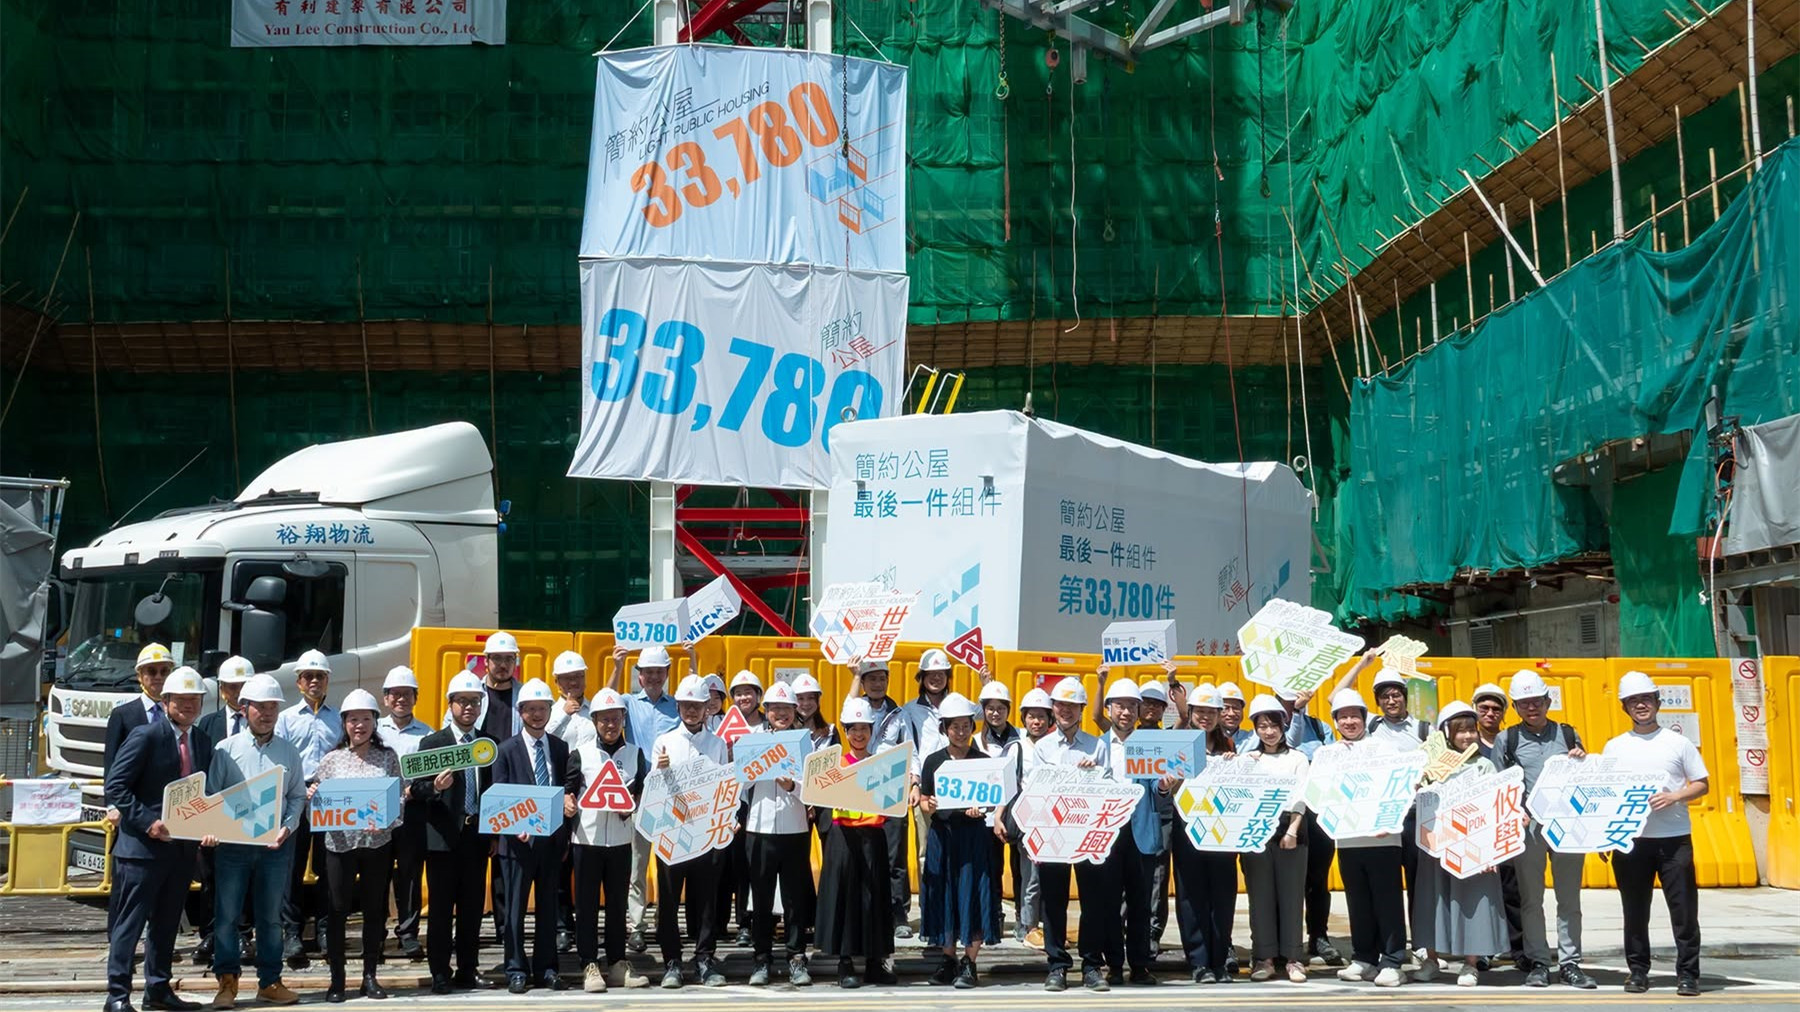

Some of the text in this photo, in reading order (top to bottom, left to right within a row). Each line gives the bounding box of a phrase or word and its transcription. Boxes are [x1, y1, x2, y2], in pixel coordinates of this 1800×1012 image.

[264, 24, 290, 36] Yau
[295, 24, 320, 35] Lee
[324, 23, 415, 35] Construction
[420, 22, 449, 36] Co.,
[604, 87, 700, 170] 簡約公屋
[638, 81, 770, 161] LIGHT PUBLIC HOUSING
[630, 81, 840, 228] 33,780
[820, 309, 863, 352] 簡約
[832, 335, 882, 370] 公屋
[591, 308, 883, 454] 33,780
[856, 449, 950, 481] 簡約公屋
[853, 487, 1003, 518] 最後一件組件
[1059, 499, 1126, 534] 簡約公屋
[276, 523, 375, 545] 裕翔物流
[1059, 535, 1157, 571] 最後一件組件
[1058, 574, 1176, 620] 第33,780件
[1223, 580, 1248, 612] 公屋
[616, 621, 677, 643] 33,780
[863, 605, 909, 659] 世運
[1104, 637, 1137, 646] 最後一件
[1289, 632, 1315, 648] TSING
[1104, 647, 1141, 663] MiC
[1283, 646, 1304, 658] FUK
[1284, 643, 1350, 691] 青福
[72, 699, 113, 718] SCANIA
[405, 748, 472, 774] 擺脫困境
[744, 743, 788, 781] 33,780
[1127, 746, 1163, 755] 最後一件
[807, 751, 837, 777] 簡約
[1127, 758, 1167, 775] MiC
[1423, 750, 1465, 780] 公屋
[689, 775, 714, 787] PUBLIC
[714, 767, 735, 782] HOUS
[814, 768, 846, 790] 公屋
[1034, 768, 1100, 784] 簡約公屋
[1212, 776, 1236, 784] LIGHT
[1263, 778, 1297, 786] HOUSING
[169, 780, 200, 808] 簡約
[313, 796, 353, 806] 最後一件
[937, 775, 1002, 804] 33,780
[1052, 786, 1141, 796] LIGHT PUBLIC HOUSING
[1224, 787, 1254, 799] TSING
[1355, 786, 1370, 798] PO
[1369, 766, 1420, 832] 欣寶
[1581, 786, 1617, 798] SHEUNG
[176, 797, 214, 820] 公屋
[700, 778, 739, 851] 恆光
[1064, 797, 1090, 810] CHOI
[1225, 802, 1243, 814] FAT
[1456, 802, 1480, 815] YAU
[1585, 802, 1600, 814] ON
[313, 808, 357, 827] MiC
[488, 798, 538, 833] 33,780
[1064, 812, 1090, 824] HING
[1235, 788, 1291, 848] 青發
[1468, 813, 1487, 832] POK
[1597, 785, 1657, 848] 常安
[1070, 798, 1134, 860] 彩興
